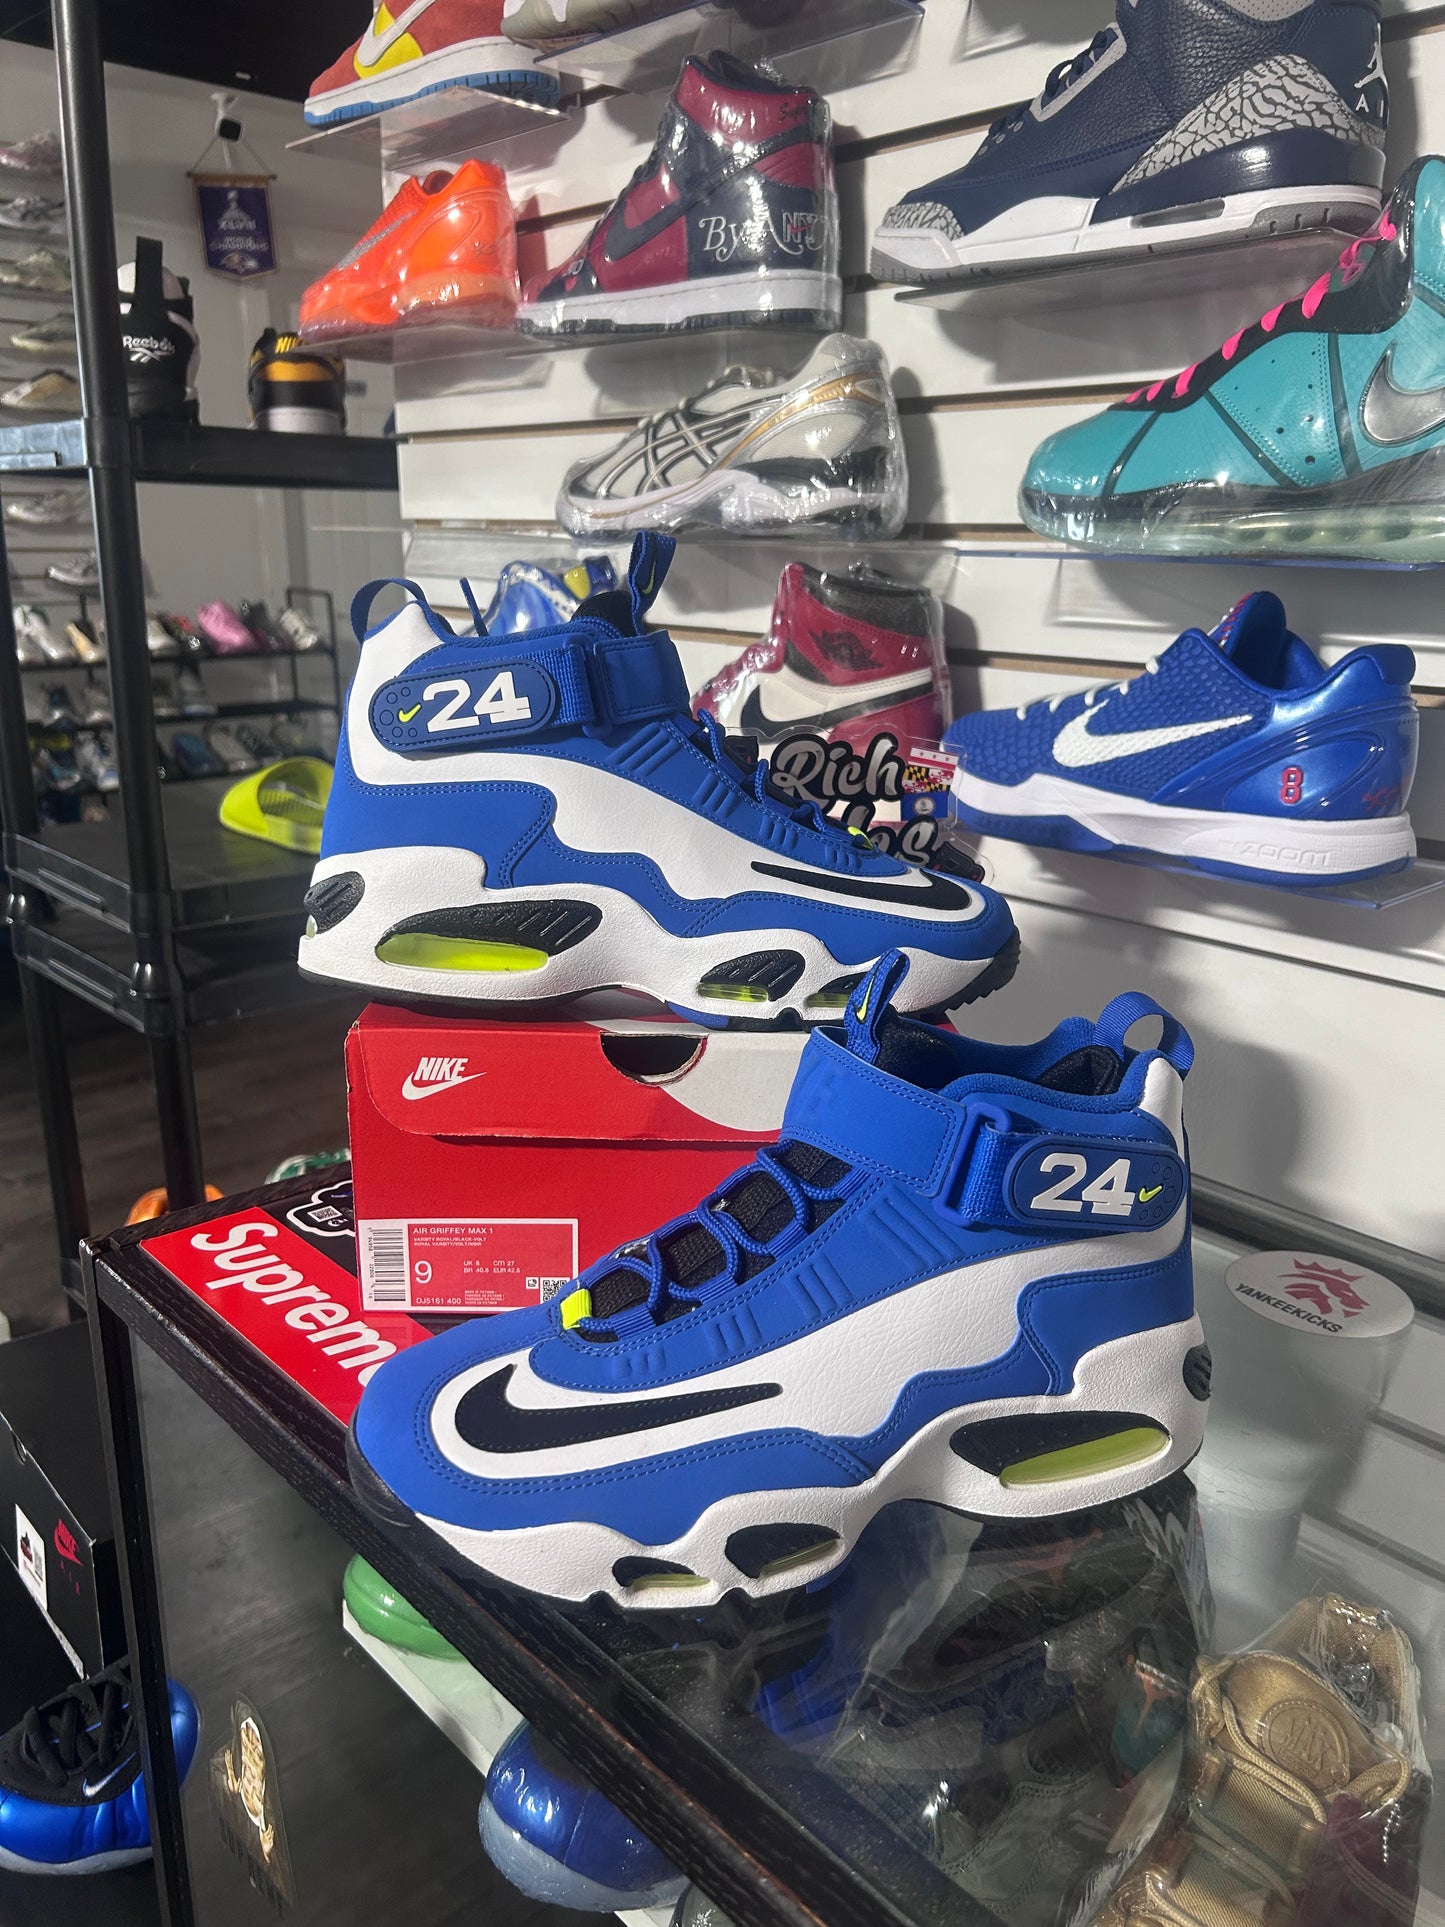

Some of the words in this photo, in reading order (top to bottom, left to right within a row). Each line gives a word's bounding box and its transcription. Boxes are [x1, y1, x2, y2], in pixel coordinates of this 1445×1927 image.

[122, 335, 175, 353] Reebok
[423, 671, 532, 733] 24
[772, 736, 901, 811] Rich
[1280, 766, 1304, 806] 8
[413, 1056, 469, 1081] NIKE
[1030, 1152, 1136, 1216] 24
[413, 1227, 428, 1235] AIR
[429, 1227, 466, 1235] GRIFFEY
[414, 1260, 433, 1284] 9
[190, 1222, 397, 1388] Suprem
[416, 1297, 444, 1305] DJ5161
[1234, 1282, 1344, 1333] YANKEEKICKS
